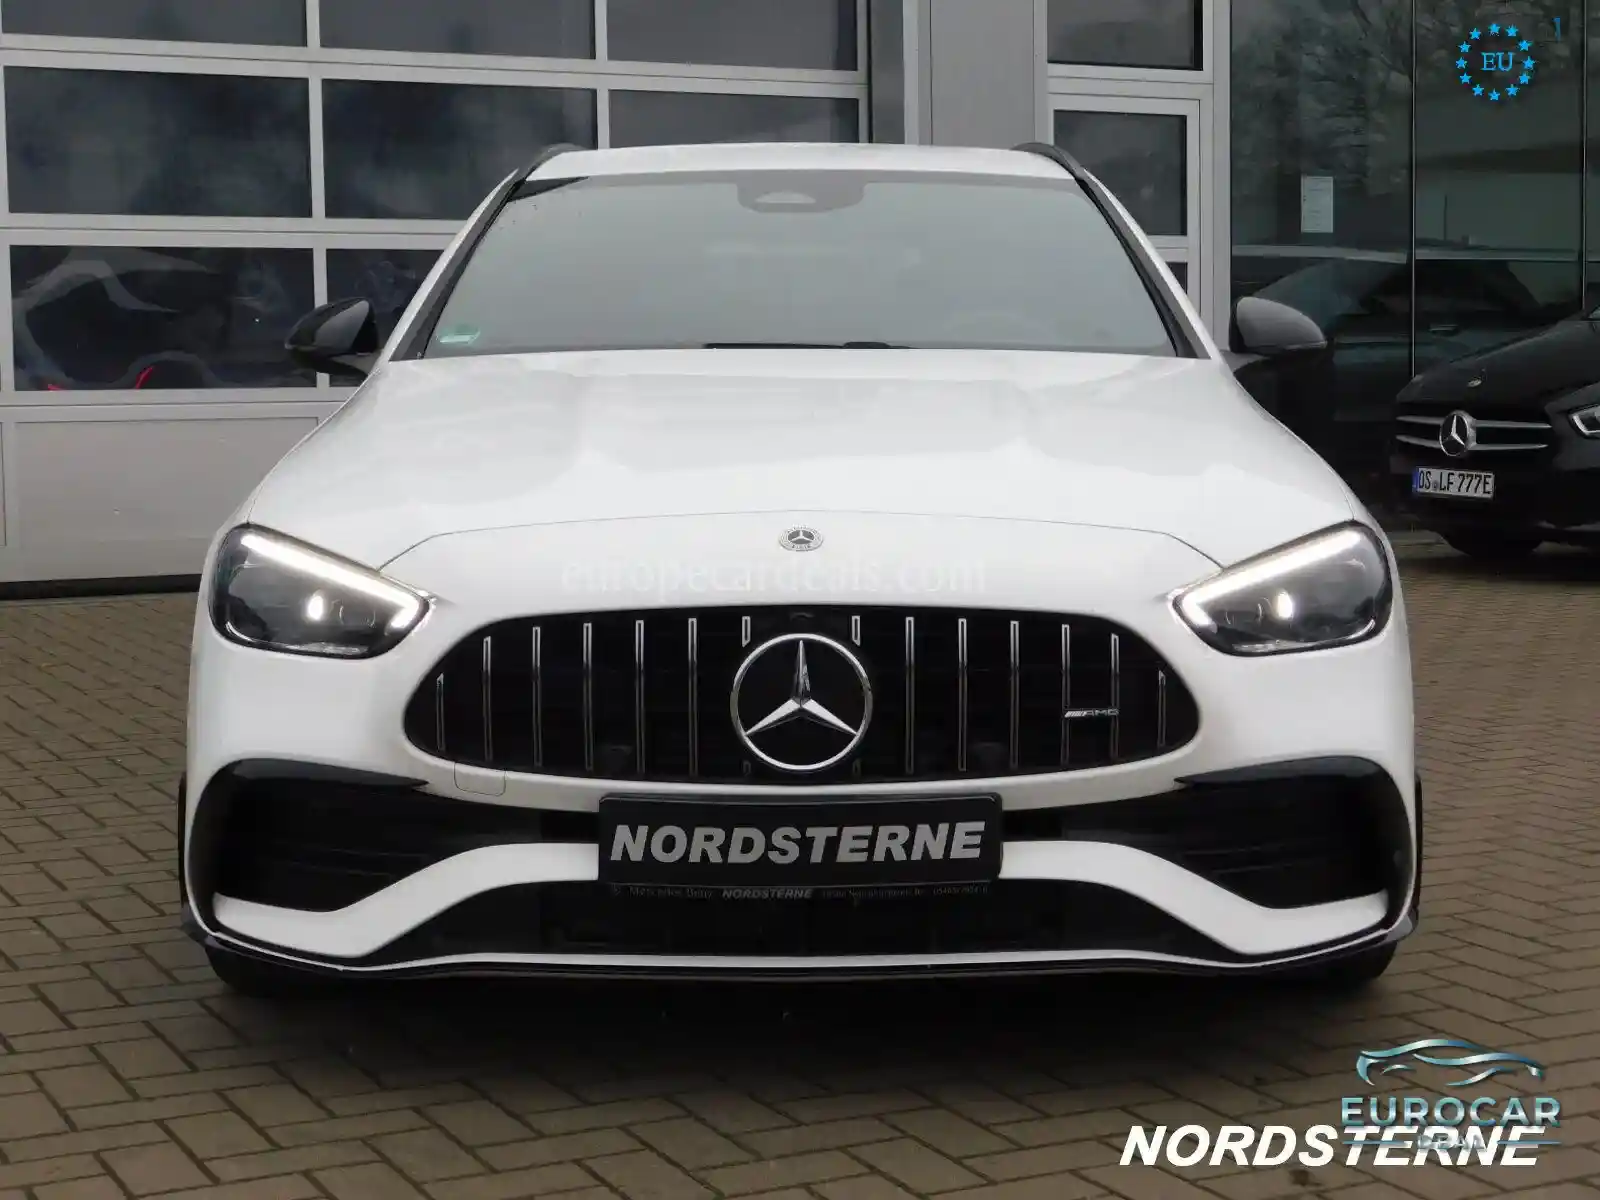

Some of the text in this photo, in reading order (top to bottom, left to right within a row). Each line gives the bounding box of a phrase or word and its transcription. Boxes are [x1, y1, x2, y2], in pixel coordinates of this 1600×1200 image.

[1439, 471, 1455, 491] LF
[1457, 472, 1492, 494] 777E
[609, 820, 986, 865] NORDSTERNE
[721, 887, 815, 900] NORDSTERNE
